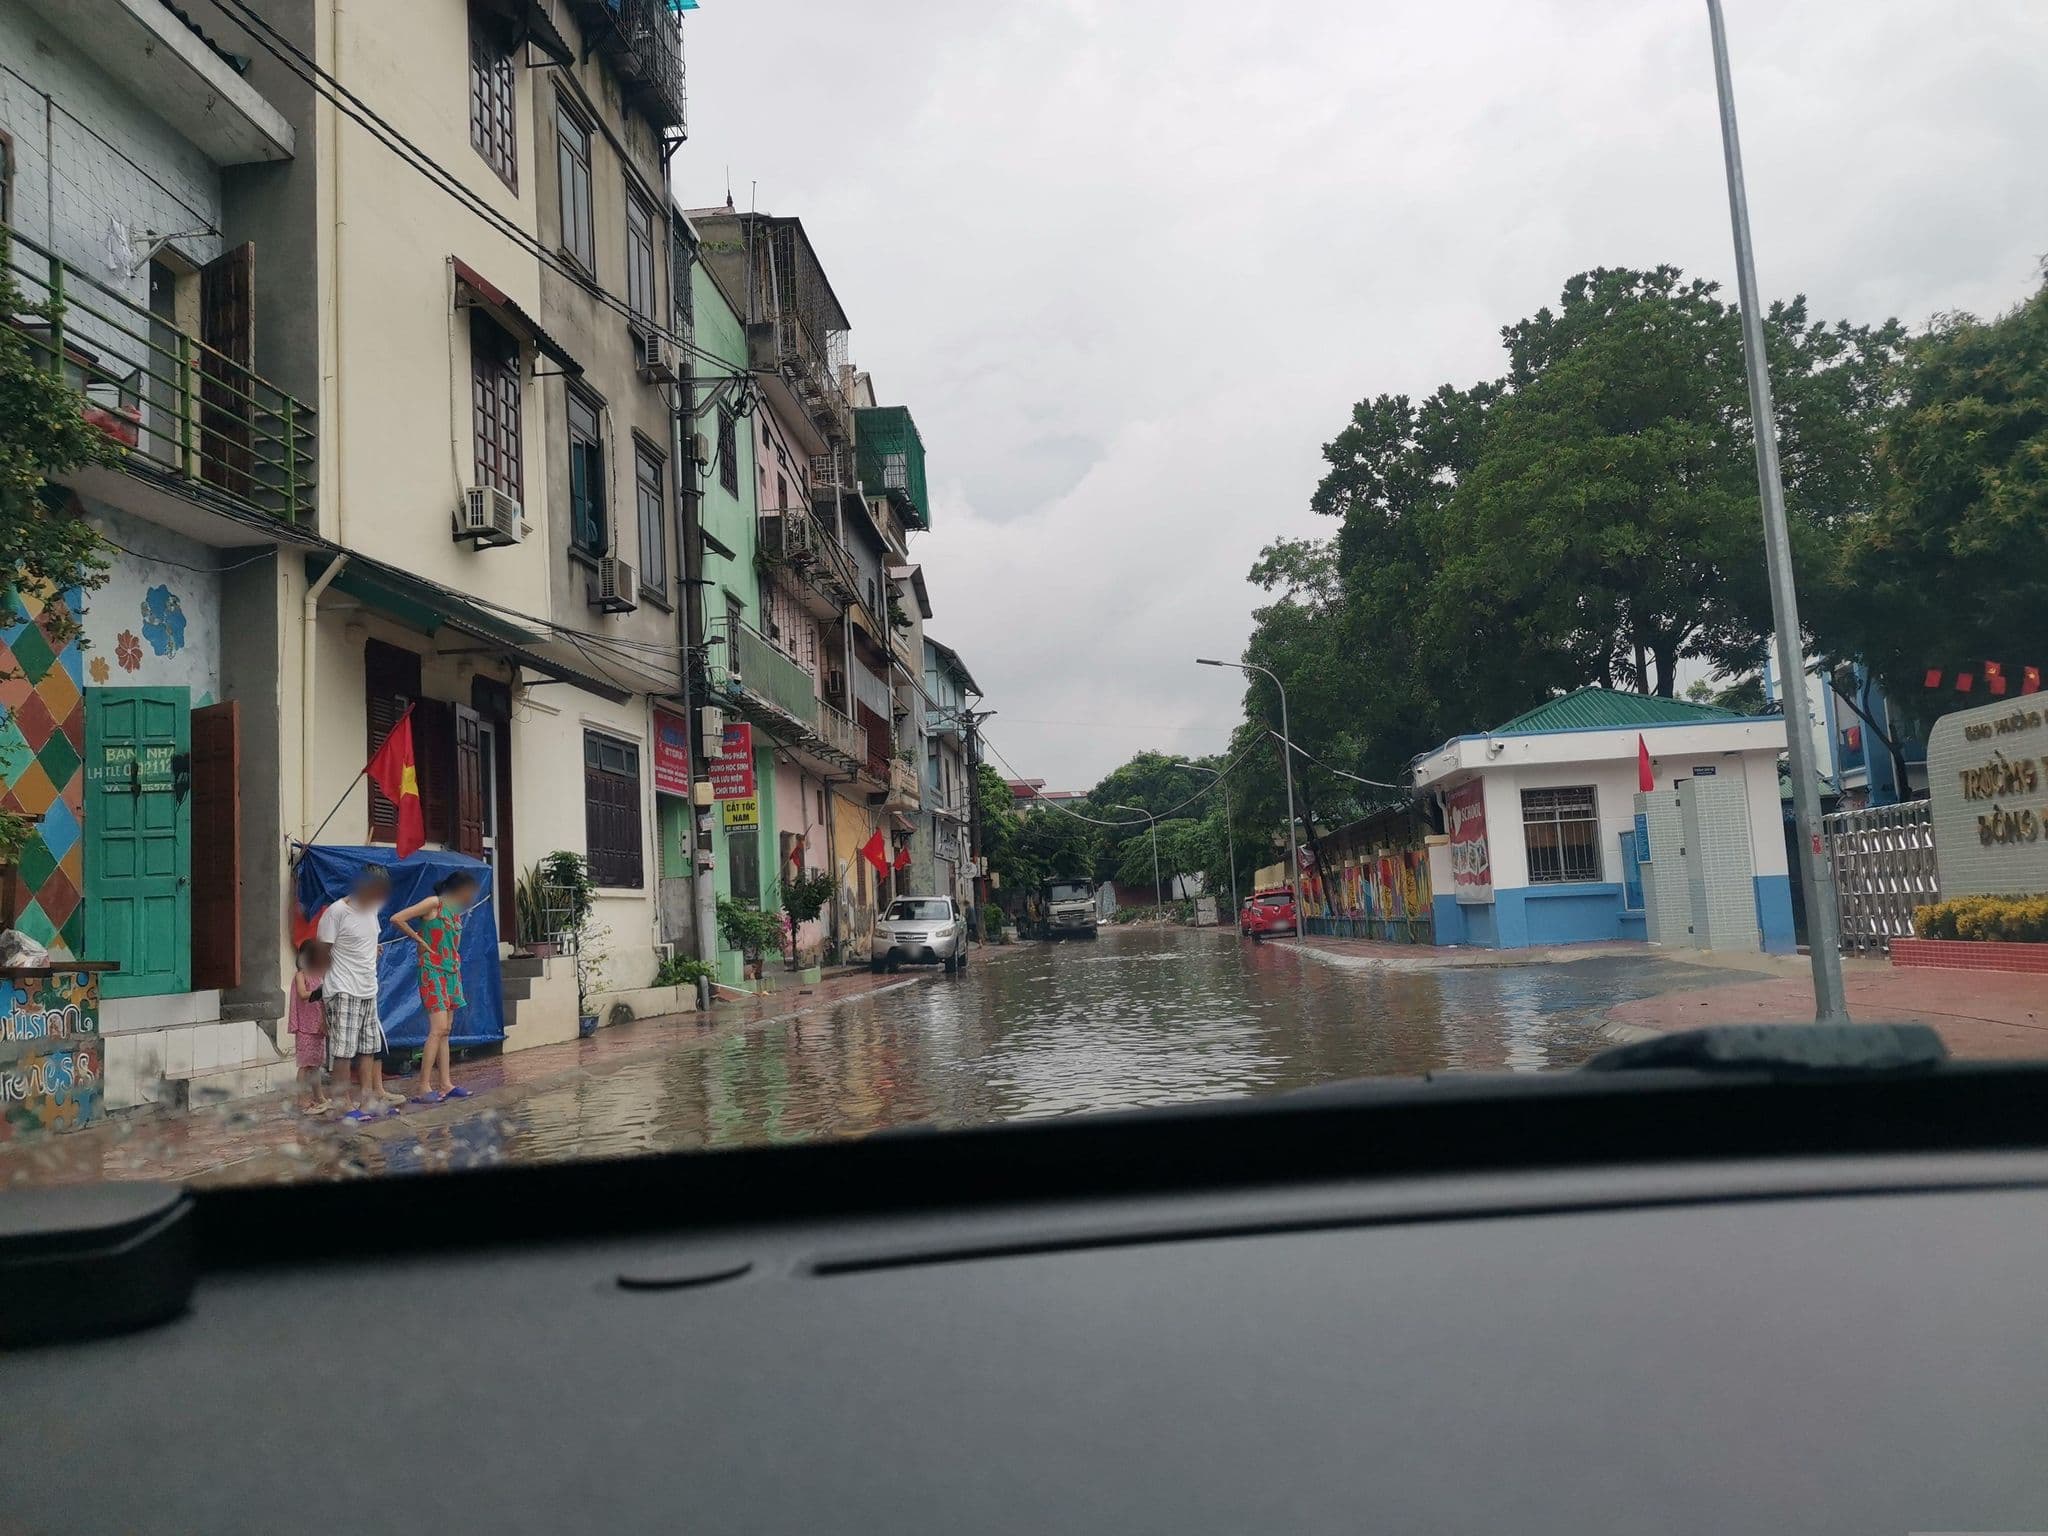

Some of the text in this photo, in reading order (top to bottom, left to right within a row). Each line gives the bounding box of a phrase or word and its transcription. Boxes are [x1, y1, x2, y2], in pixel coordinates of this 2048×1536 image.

[1959, 750, 2037, 800] TRƯỜNG
[732, 813, 750, 822] NAM
[1461, 803, 1481, 821] SCHOOL
